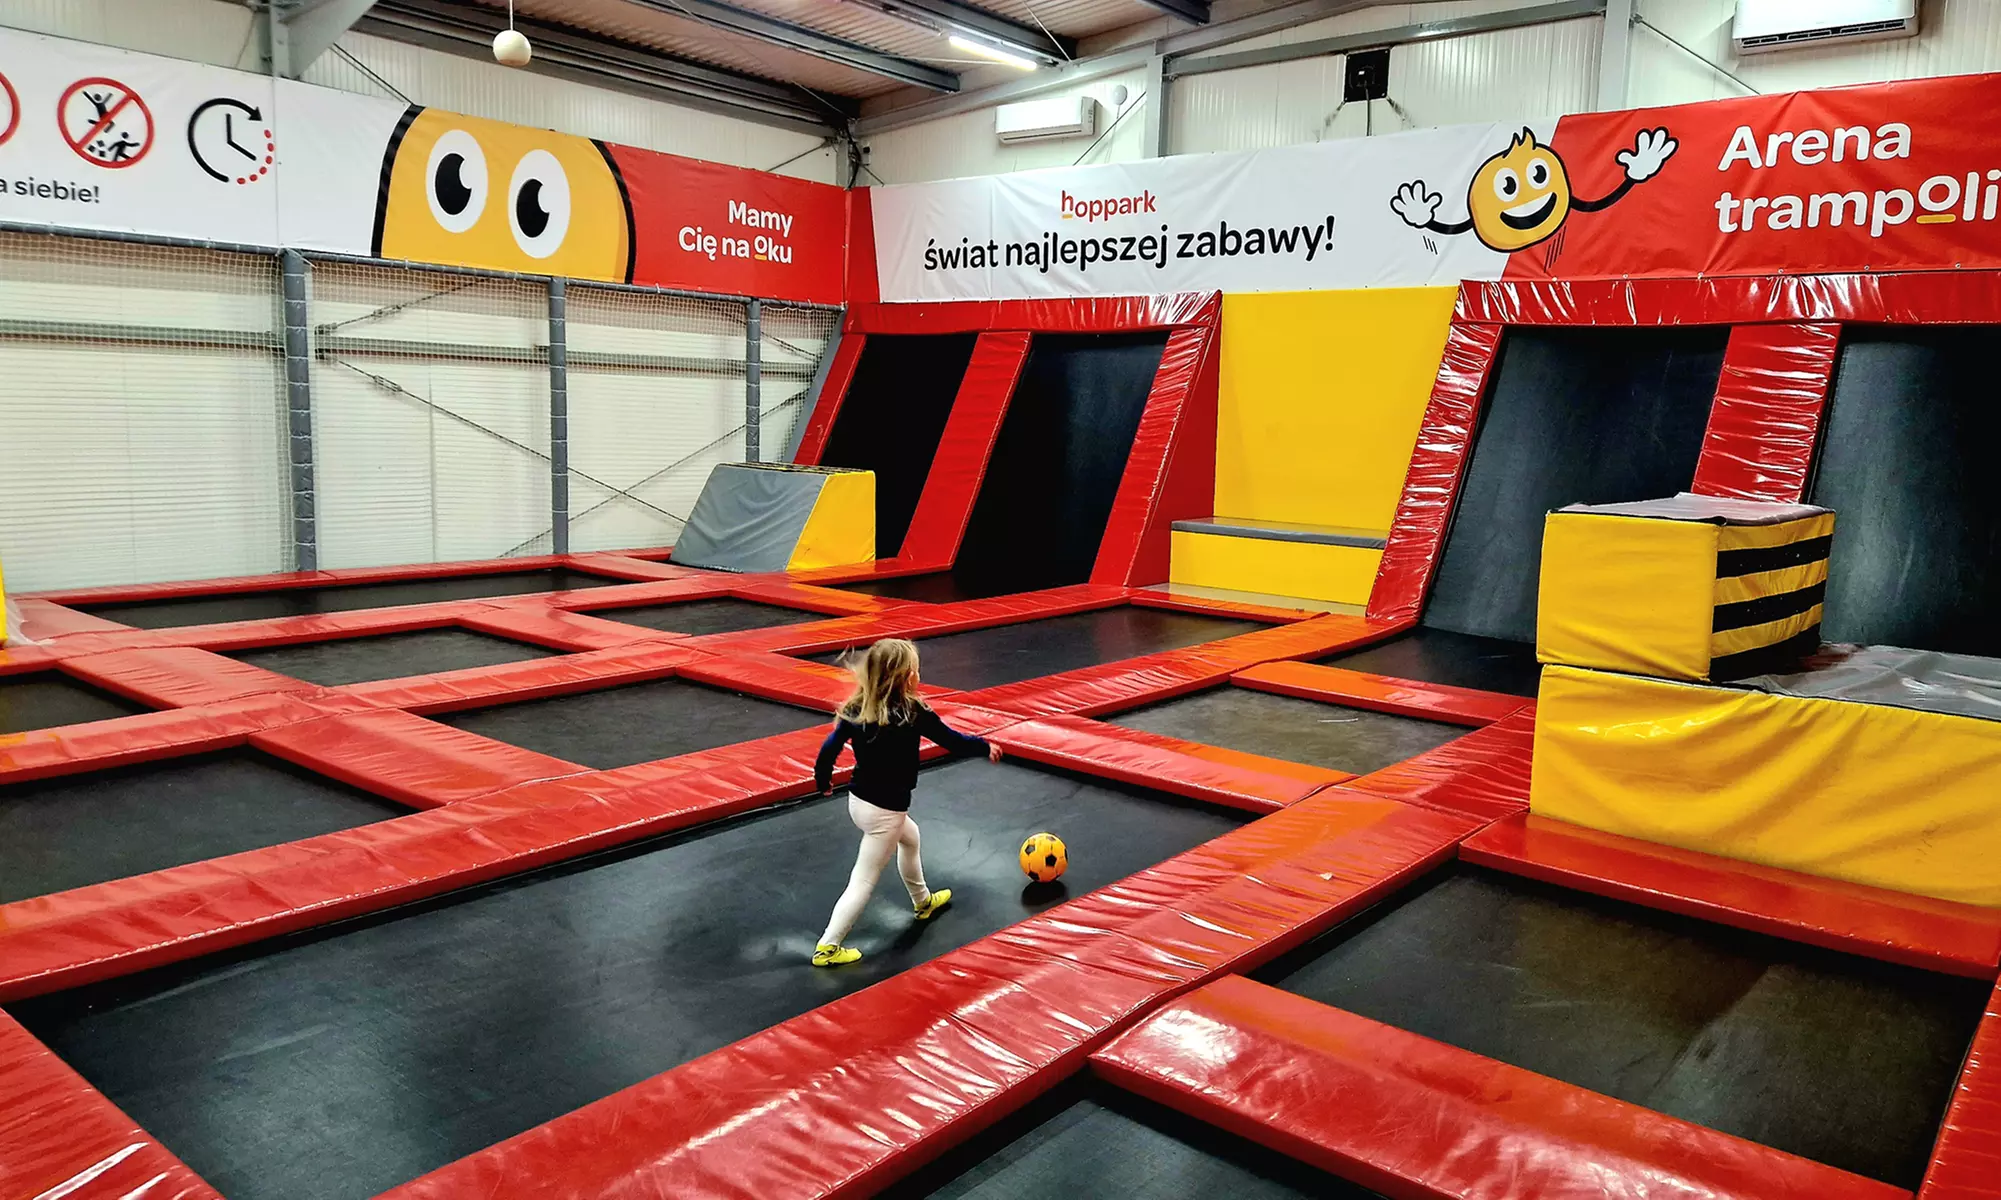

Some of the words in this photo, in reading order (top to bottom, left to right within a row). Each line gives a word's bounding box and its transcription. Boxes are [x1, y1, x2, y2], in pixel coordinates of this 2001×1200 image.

[1717, 122, 1912, 172] Arena
[14, 176, 100, 204] siebie!
[1061, 189, 1157, 223] hoppark
[1714, 169, 2001, 238] trampoli
[728, 199, 793, 238] Mamy
[678, 226, 718, 261] Cię
[721, 236, 750, 259] na
[754, 235, 793, 264] oku
[924, 237, 999, 271] świat
[1005, 224, 1168, 274] najlepszej
[1176, 215, 1335, 262] zabawy!
